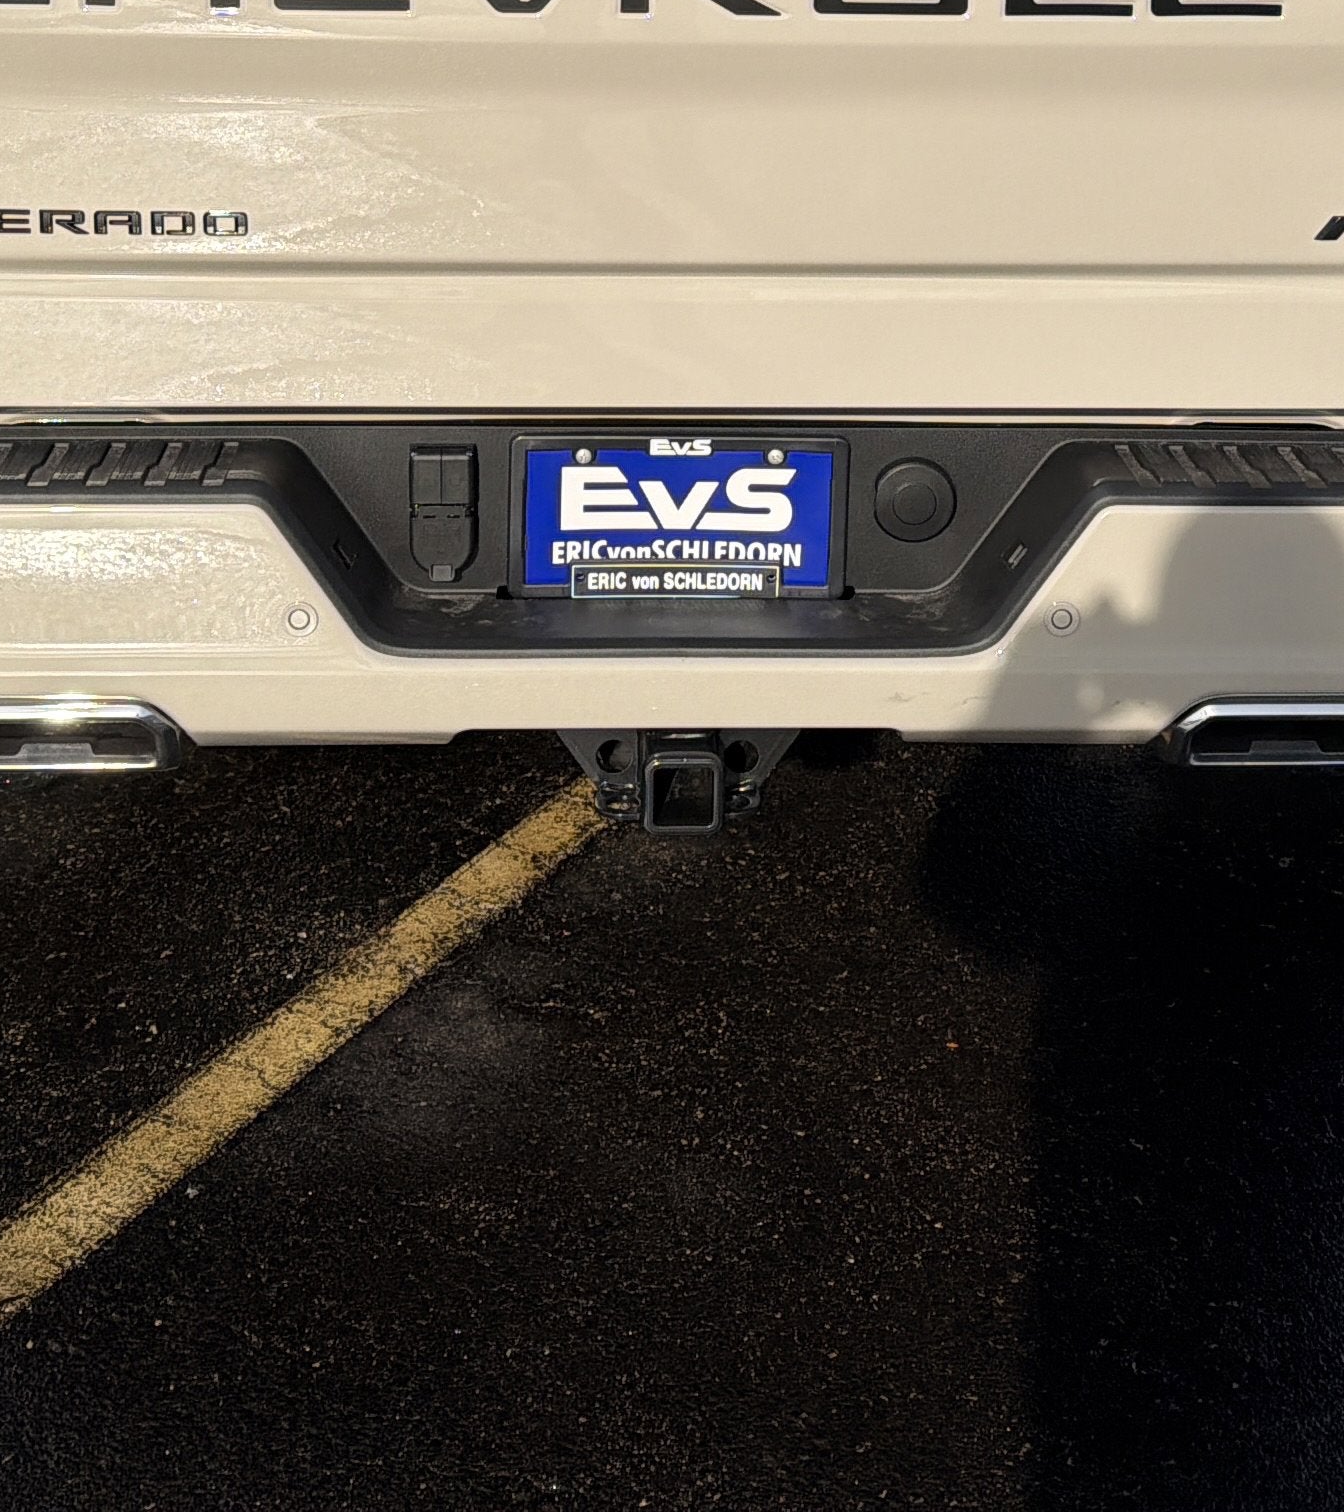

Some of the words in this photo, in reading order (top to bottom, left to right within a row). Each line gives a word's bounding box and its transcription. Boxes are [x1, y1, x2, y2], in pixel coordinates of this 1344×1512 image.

[587, 571, 627, 590] ERIC
[632, 574, 660, 590] von
[663, 571, 764, 592] SCHLEDORN
